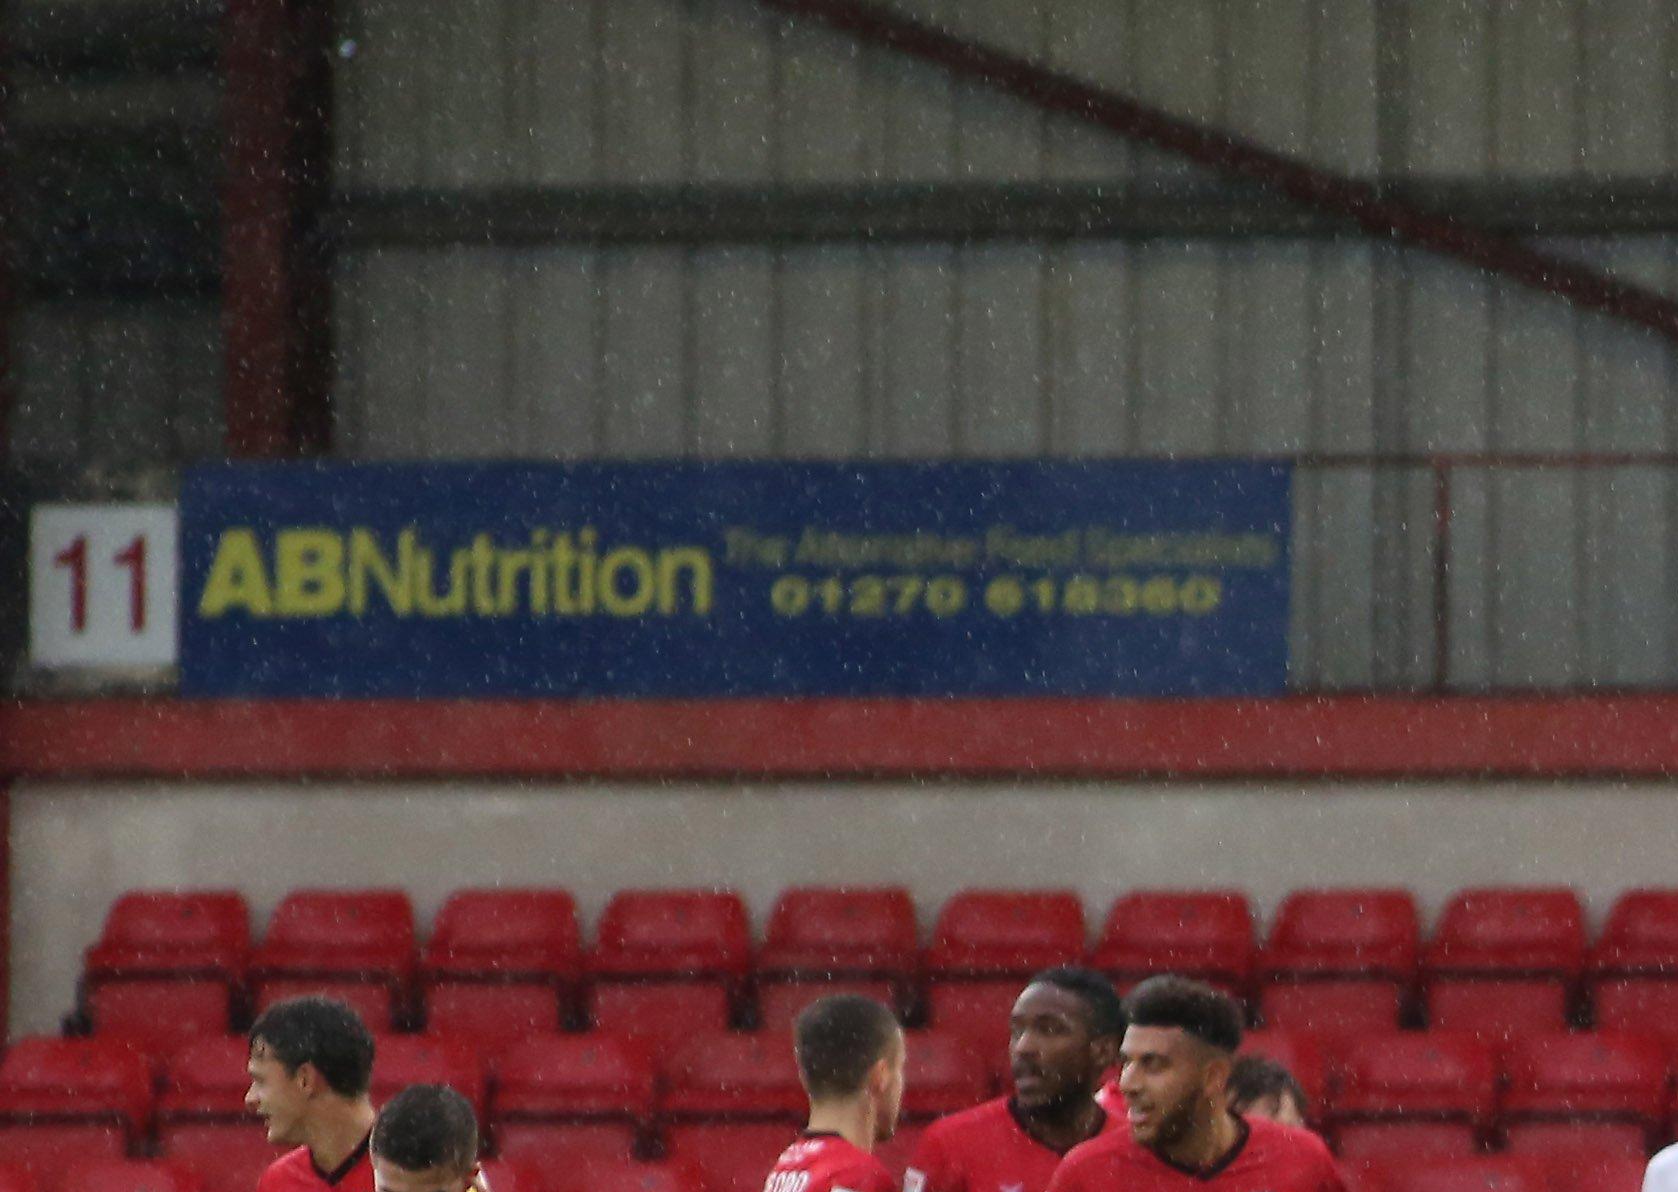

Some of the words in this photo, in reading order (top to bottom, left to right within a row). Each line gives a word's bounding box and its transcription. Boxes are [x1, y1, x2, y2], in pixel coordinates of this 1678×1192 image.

[53, 533, 149, 636] 11
[200, 526, 713, 618] ABNutrition
[770, 575, 967, 617] 01270
